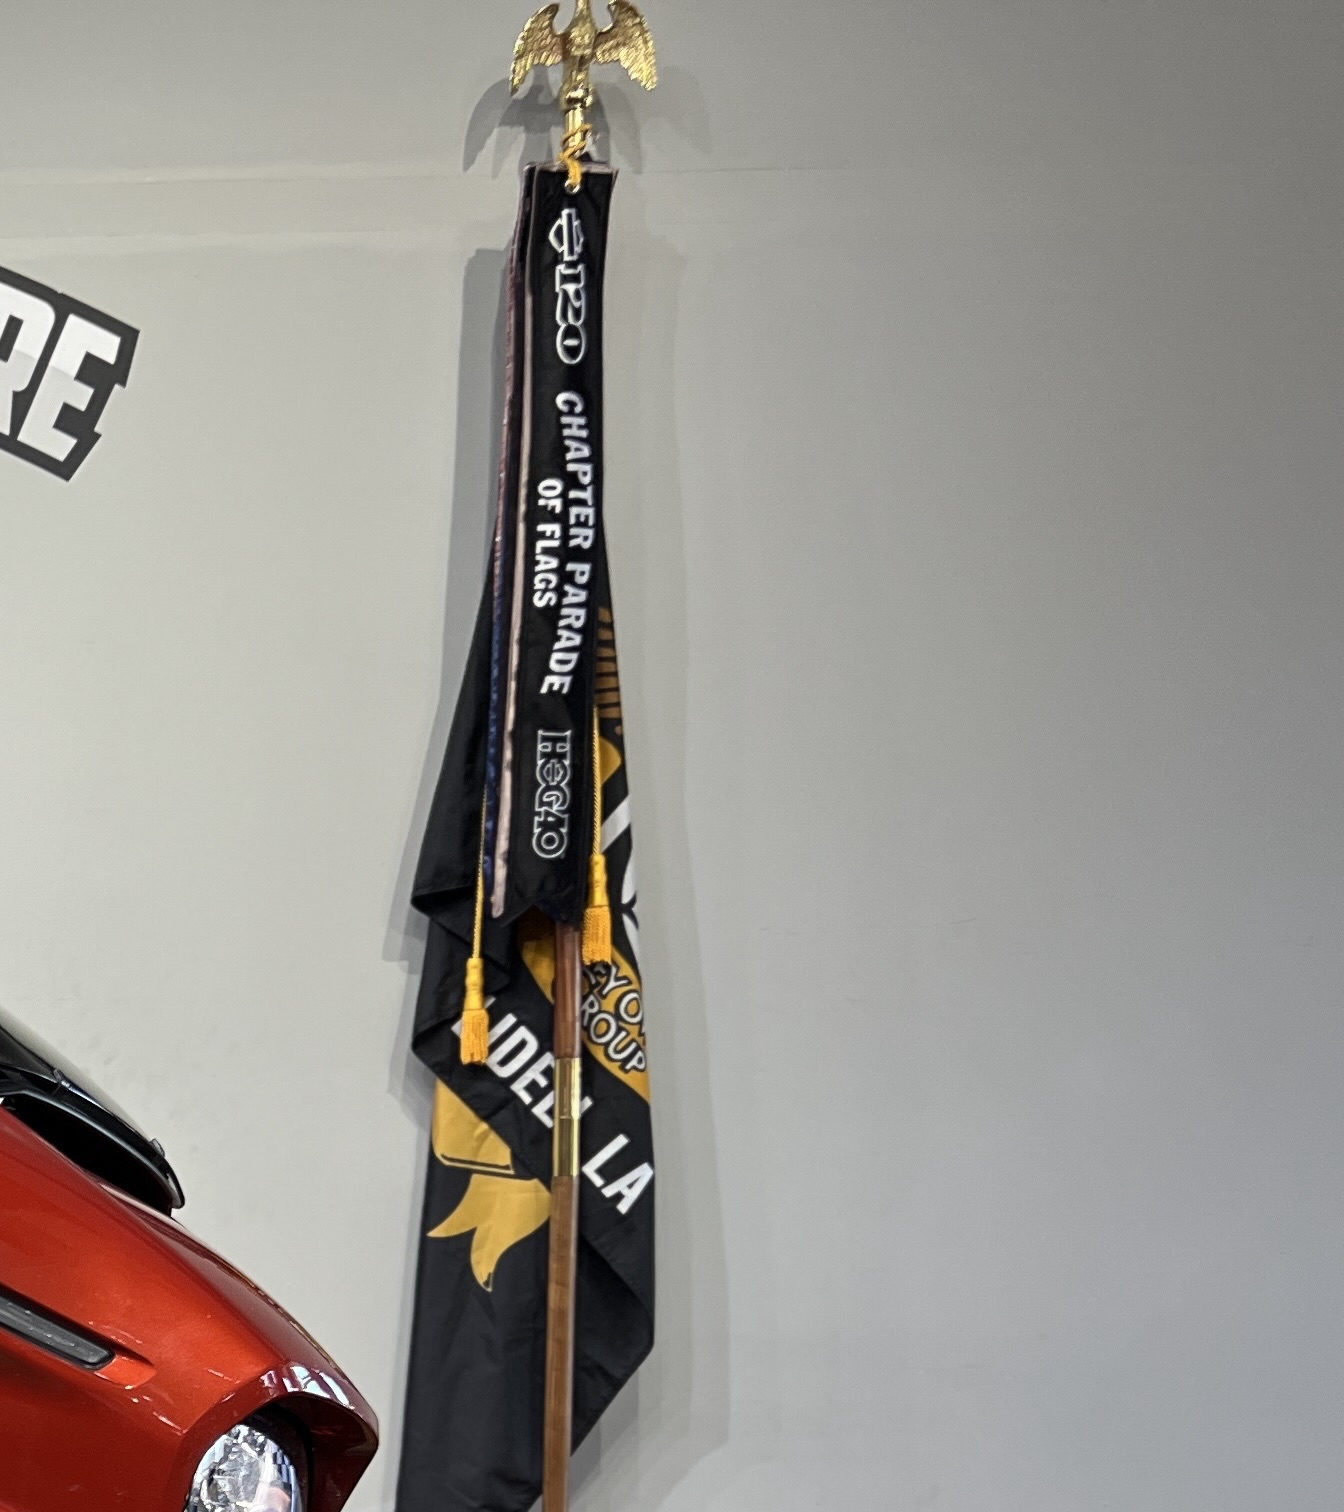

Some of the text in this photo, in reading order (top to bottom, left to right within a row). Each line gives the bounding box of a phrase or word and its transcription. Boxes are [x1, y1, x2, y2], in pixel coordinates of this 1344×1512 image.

[532, 477, 564, 608] OF FLAGS
[539, 390, 596, 695] CHAPTER PARADE
[579, 994, 647, 1071] ROUP
[581, 1133, 655, 1215] LA
